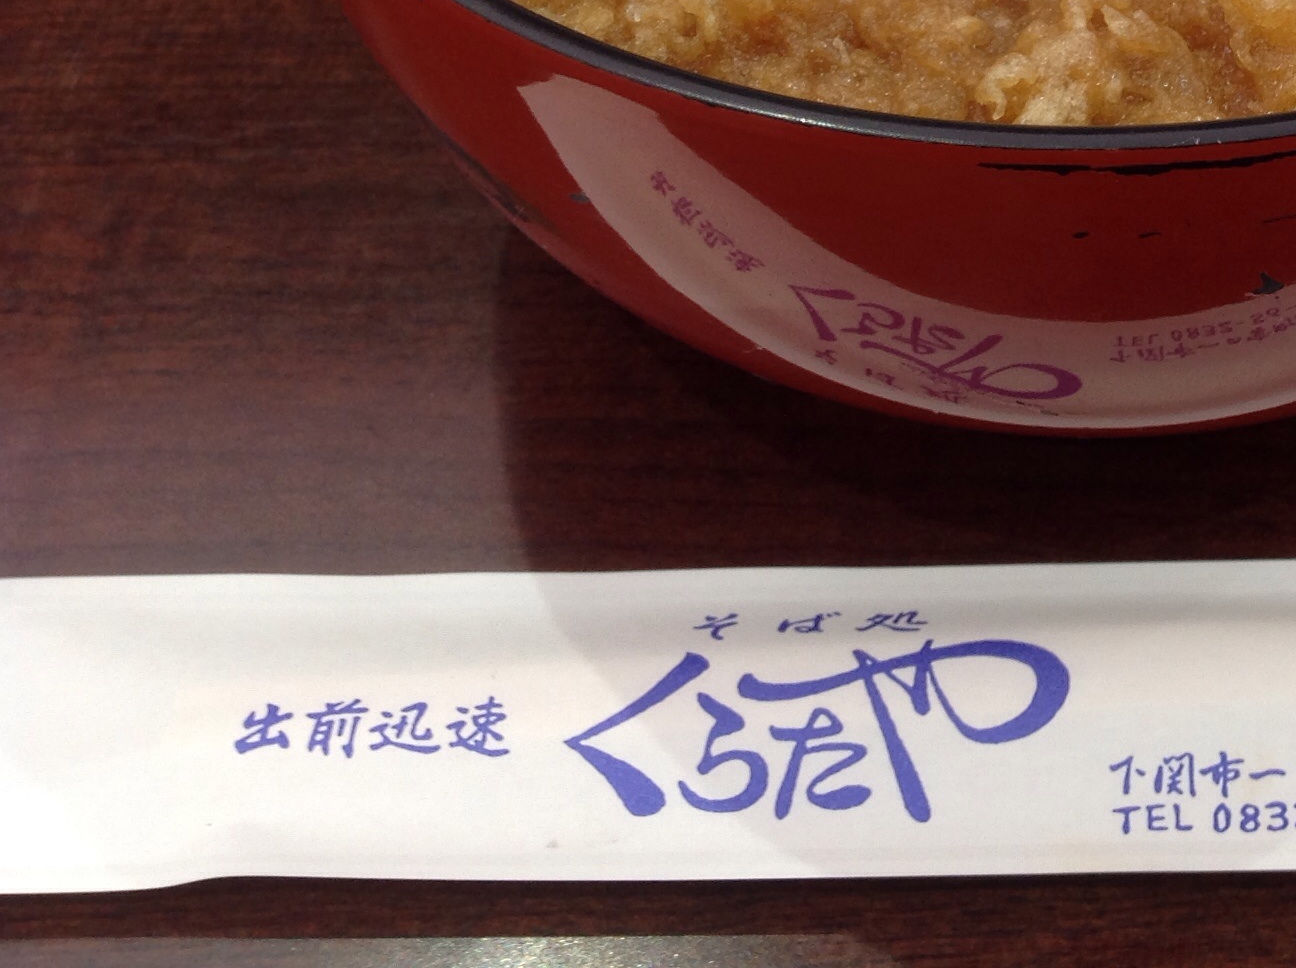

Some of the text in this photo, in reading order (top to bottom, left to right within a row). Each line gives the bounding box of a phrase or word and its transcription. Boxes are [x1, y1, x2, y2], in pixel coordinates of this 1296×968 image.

[692, 610, 928, 638] そば処
[233, 696, 512, 758] 出前迅速
[566, 638, 1071, 824] くらたや
[1112, 804, 1193, 835] TEL
